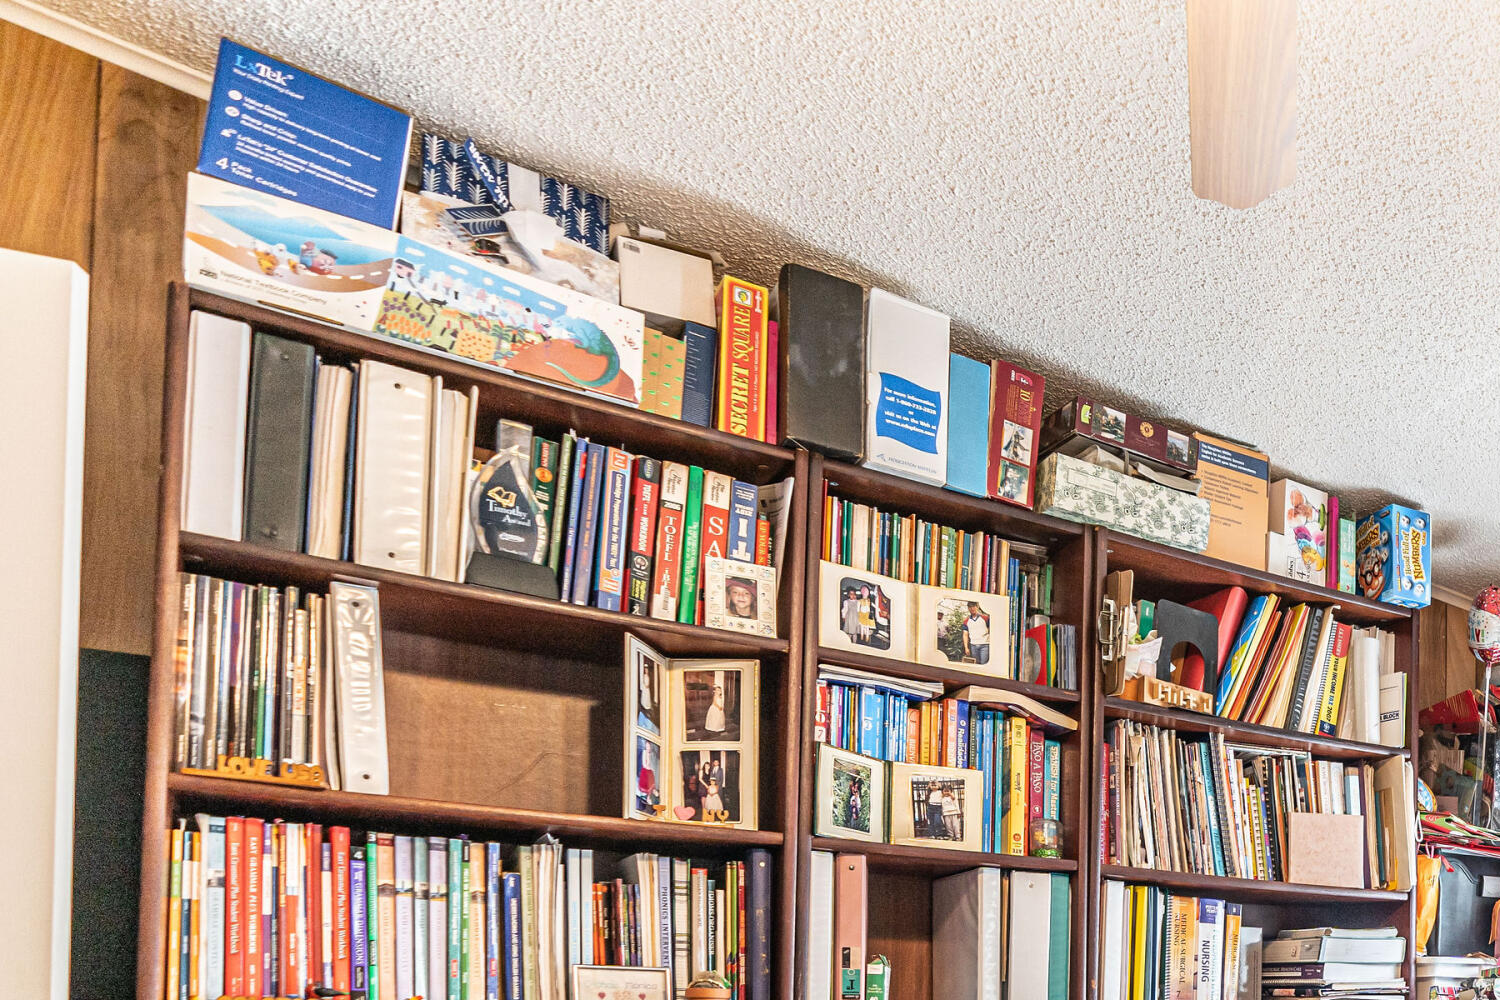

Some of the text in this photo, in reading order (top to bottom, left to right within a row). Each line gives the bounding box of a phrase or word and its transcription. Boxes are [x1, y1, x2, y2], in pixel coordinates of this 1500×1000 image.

[216, 157, 229, 170] 4
[730, 304, 754, 436] SECRET SQUARE
[486, 499, 529, 520] Timothy
[502, 514, 531, 527] Award
[638, 516, 649, 552] WORKBOOK
[663, 515, 678, 562] TOEFL
[707, 516, 725, 558] SA
[1410, 527, 1425, 581] NUMBERS
[1330, 671, 1338, 694] INCOME
[1032, 741, 1043, 761] PASO
[1032, 772, 1043, 793] PASO
[368, 833, 377, 843] 3
[353, 850, 363, 860] 4
[661, 886, 669, 920] PHONICS
[1179, 913, 1188, 984] MEDICAL-SURGICAL
[1201, 940, 1211, 983] NURSING
